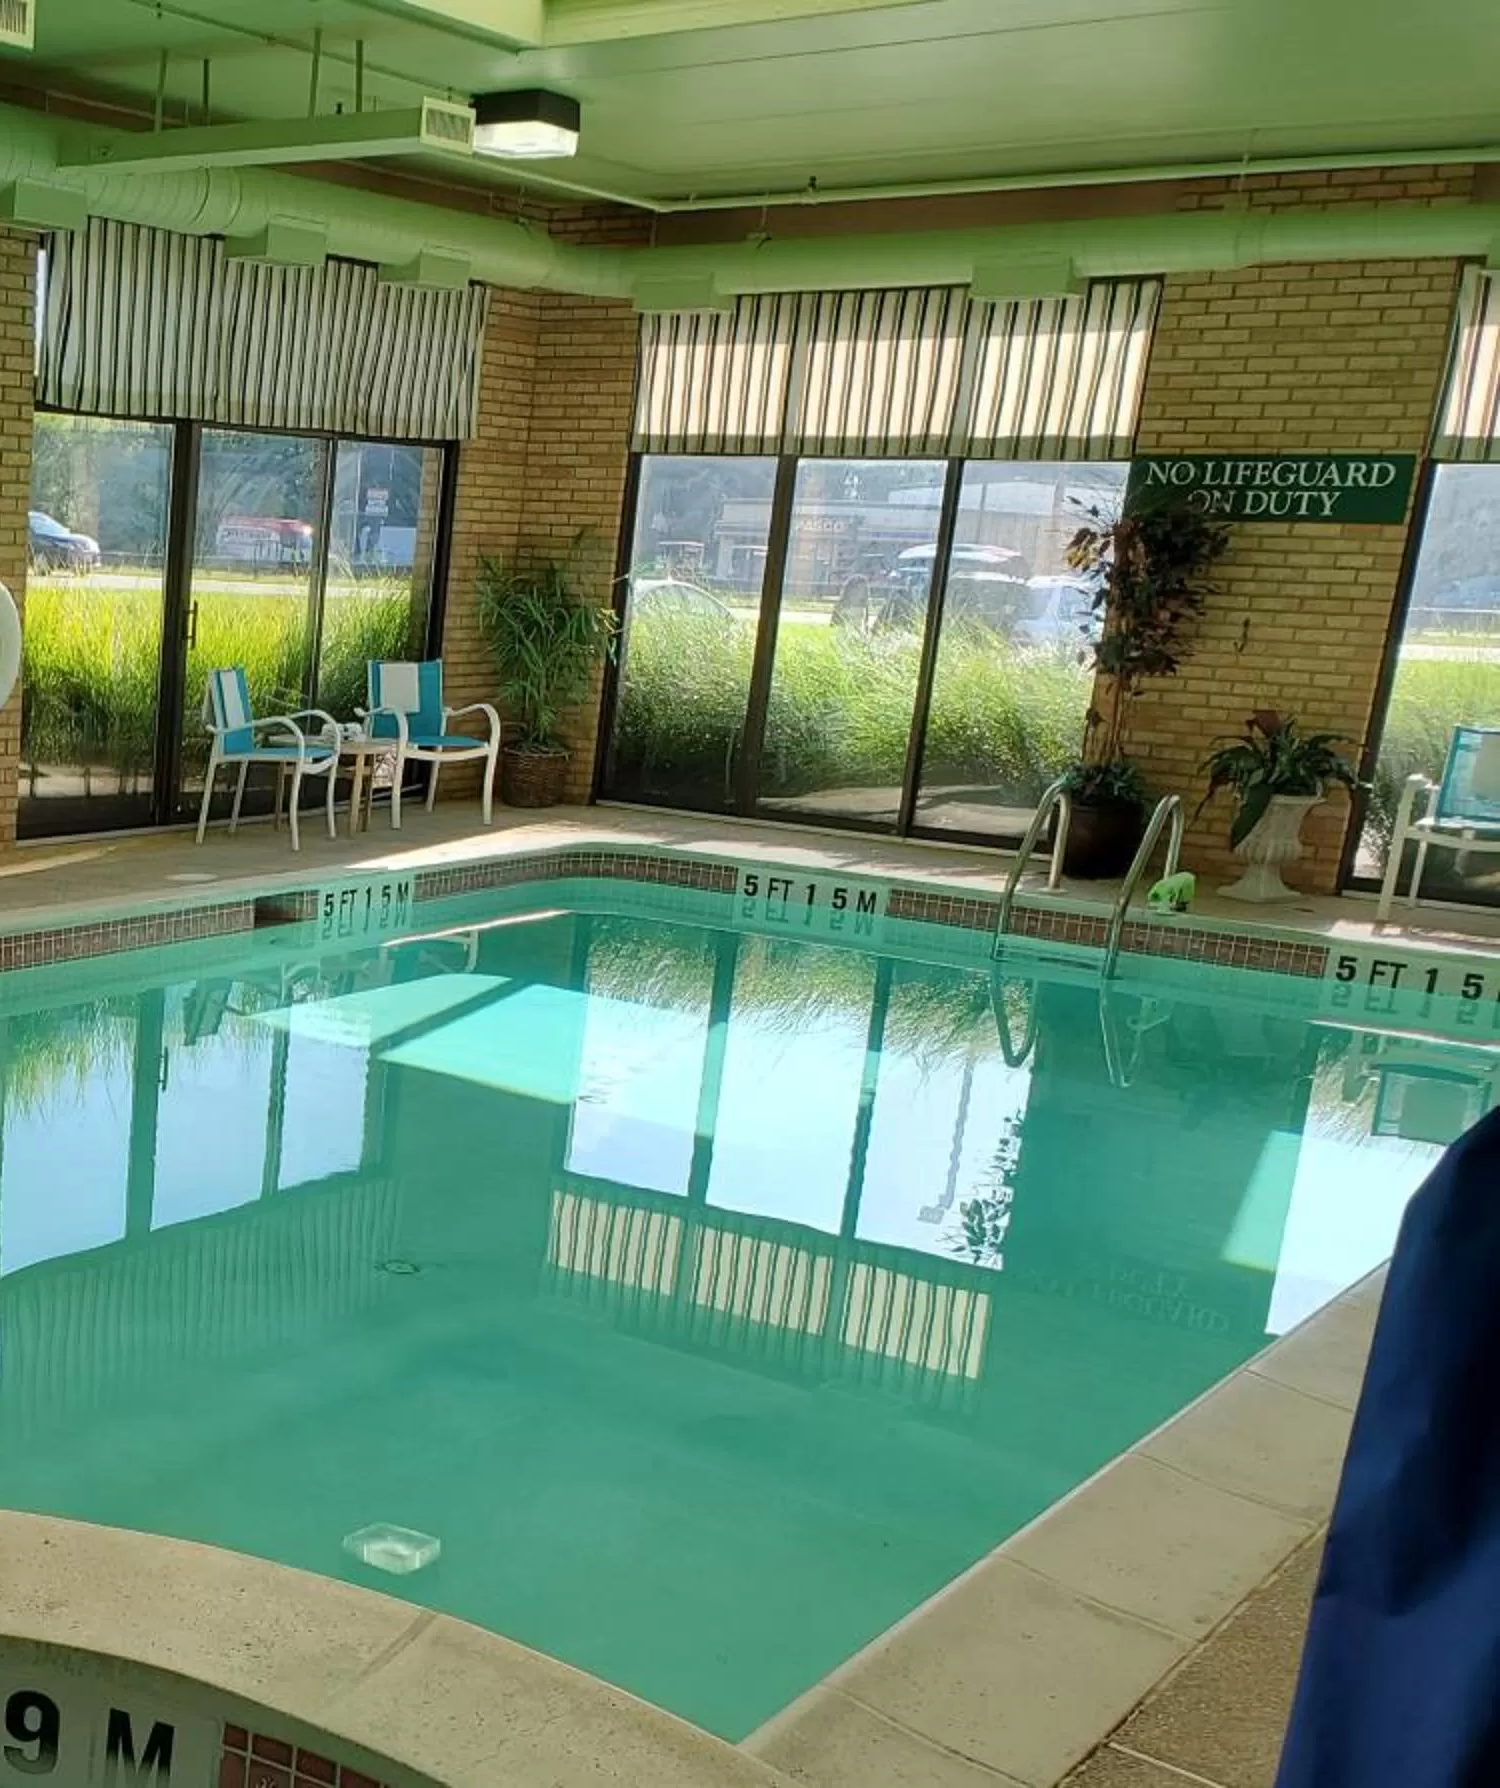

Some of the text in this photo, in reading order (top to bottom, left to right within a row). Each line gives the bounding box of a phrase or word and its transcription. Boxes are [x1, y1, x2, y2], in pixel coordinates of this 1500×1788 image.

[1145, 461, 1397, 488] NO LIFEGUARD
[1243, 491, 1342, 517] DUTY
